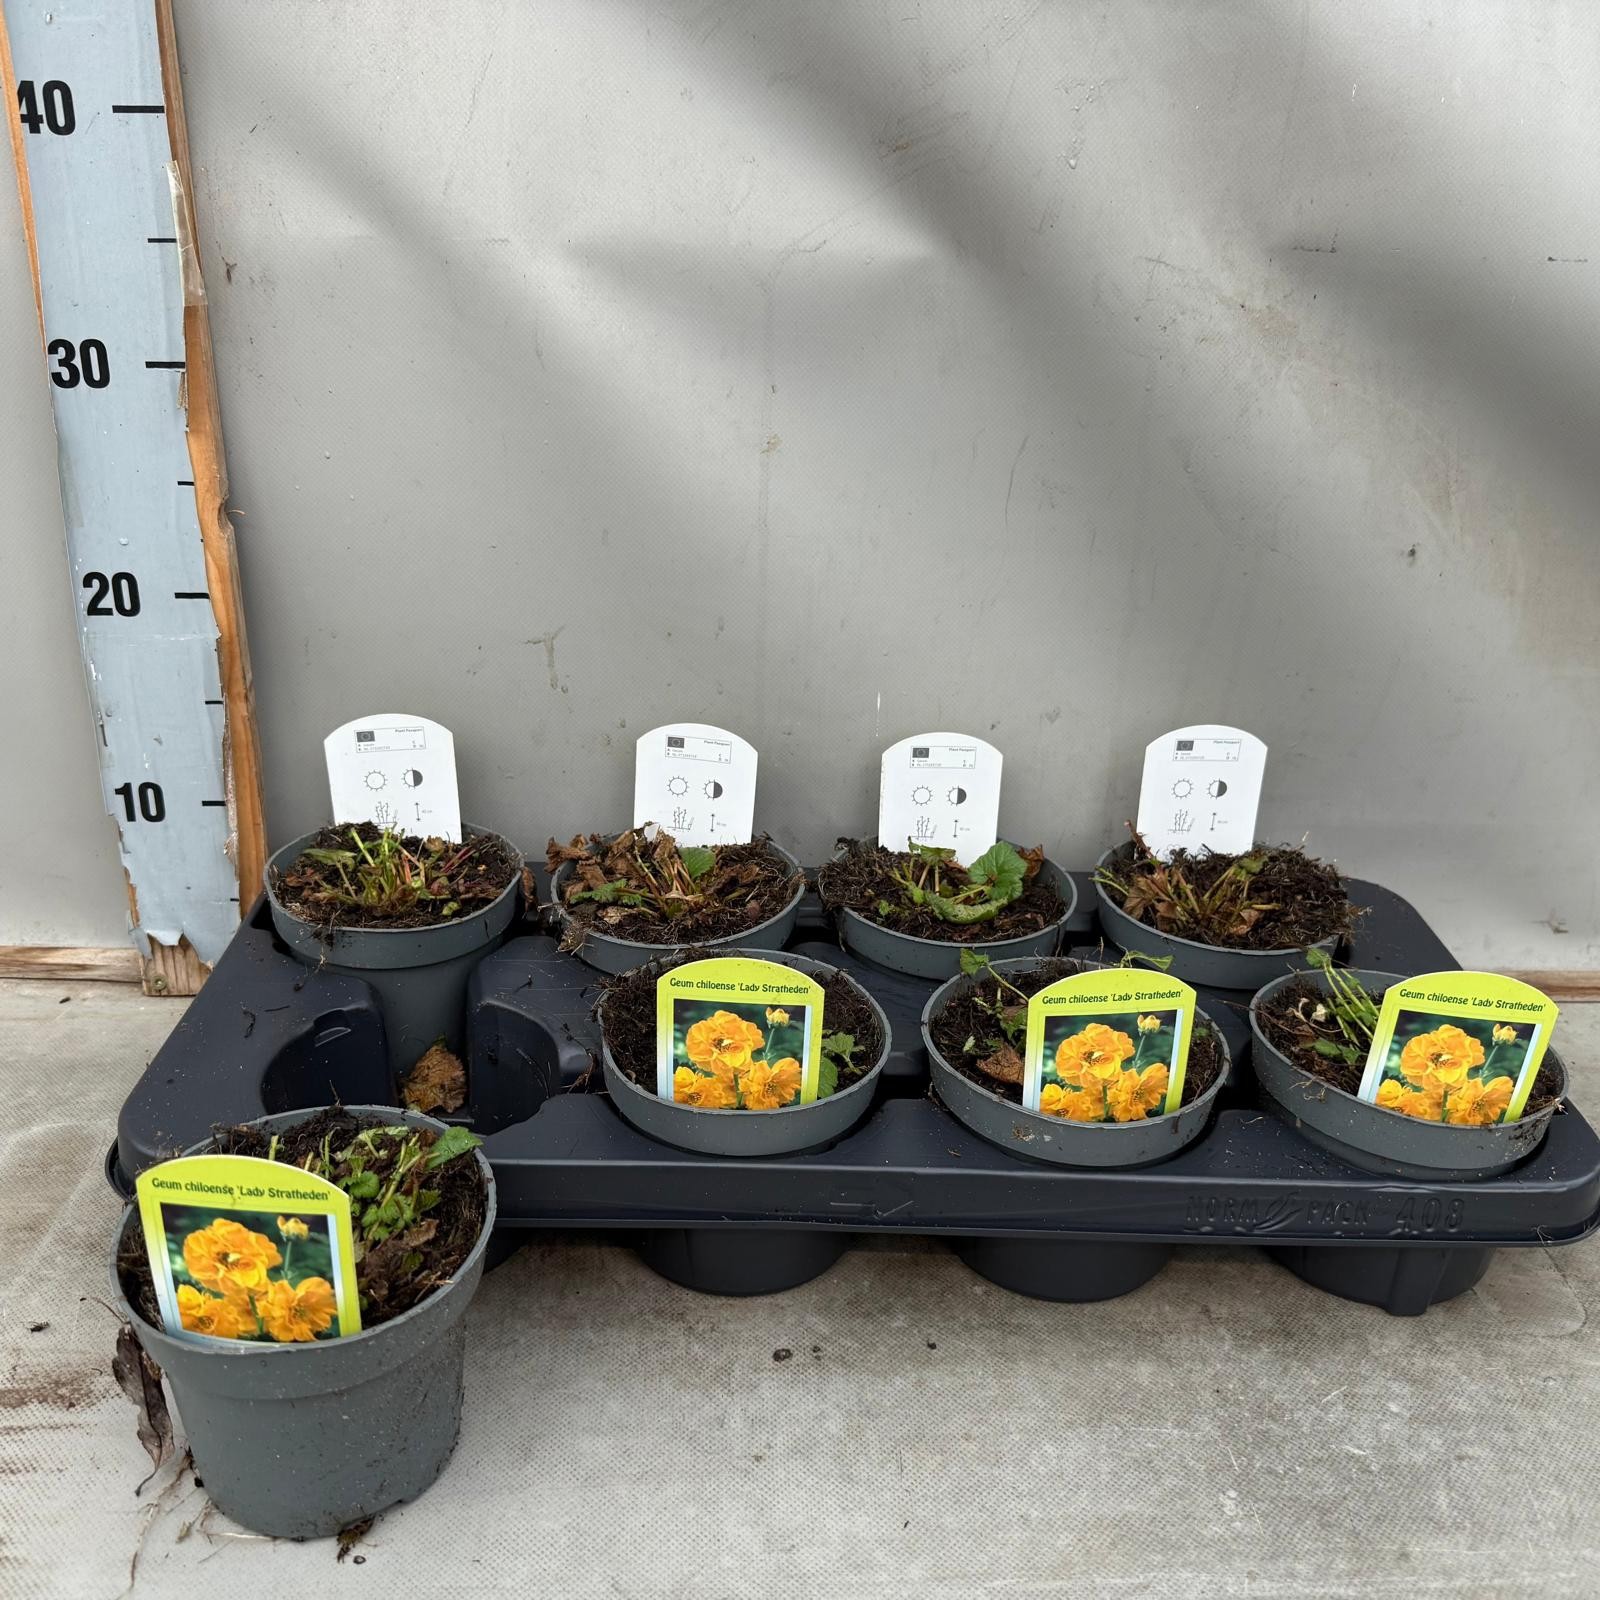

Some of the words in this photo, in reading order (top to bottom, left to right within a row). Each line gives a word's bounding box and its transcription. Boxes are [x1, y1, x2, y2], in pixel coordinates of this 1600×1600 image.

[17, 79, 76, 136] 40
[48, 338, 110, 389] 30
[83, 571, 140, 618] 20
[114, 781, 165, 823] 10
[670, 977, 694, 988] Geum
[696, 979, 736, 991] chiloense
[738, 982, 760, 993] 'Lady
[762, 983, 811, 995] Stratheden'
[1042, 995, 1067, 1005] Geum
[1068, 993, 1109, 1004] chiloense
[1111, 992, 1133, 1002] 'Lady
[1134, 989, 1184, 1001] Stratheden'
[1399, 988, 1425, 1000] Geum
[1427, 992, 1468, 1006] chiloense
[1471, 996, 1494, 1008] 'Lady
[1495, 999, 1546, 1013] Stratheden'
[152, 1177, 182, 1191] Geum
[184, 1180, 234, 1196] chiloense
[237, 1185, 266, 1199] 'Lady
[268, 1187, 331, 1201] Stratheden'
[1185, 1197, 1258, 1224] NORM
[1306, 1199, 1370, 1226] PACK
[1395, 1197, 1465, 1233] 408
